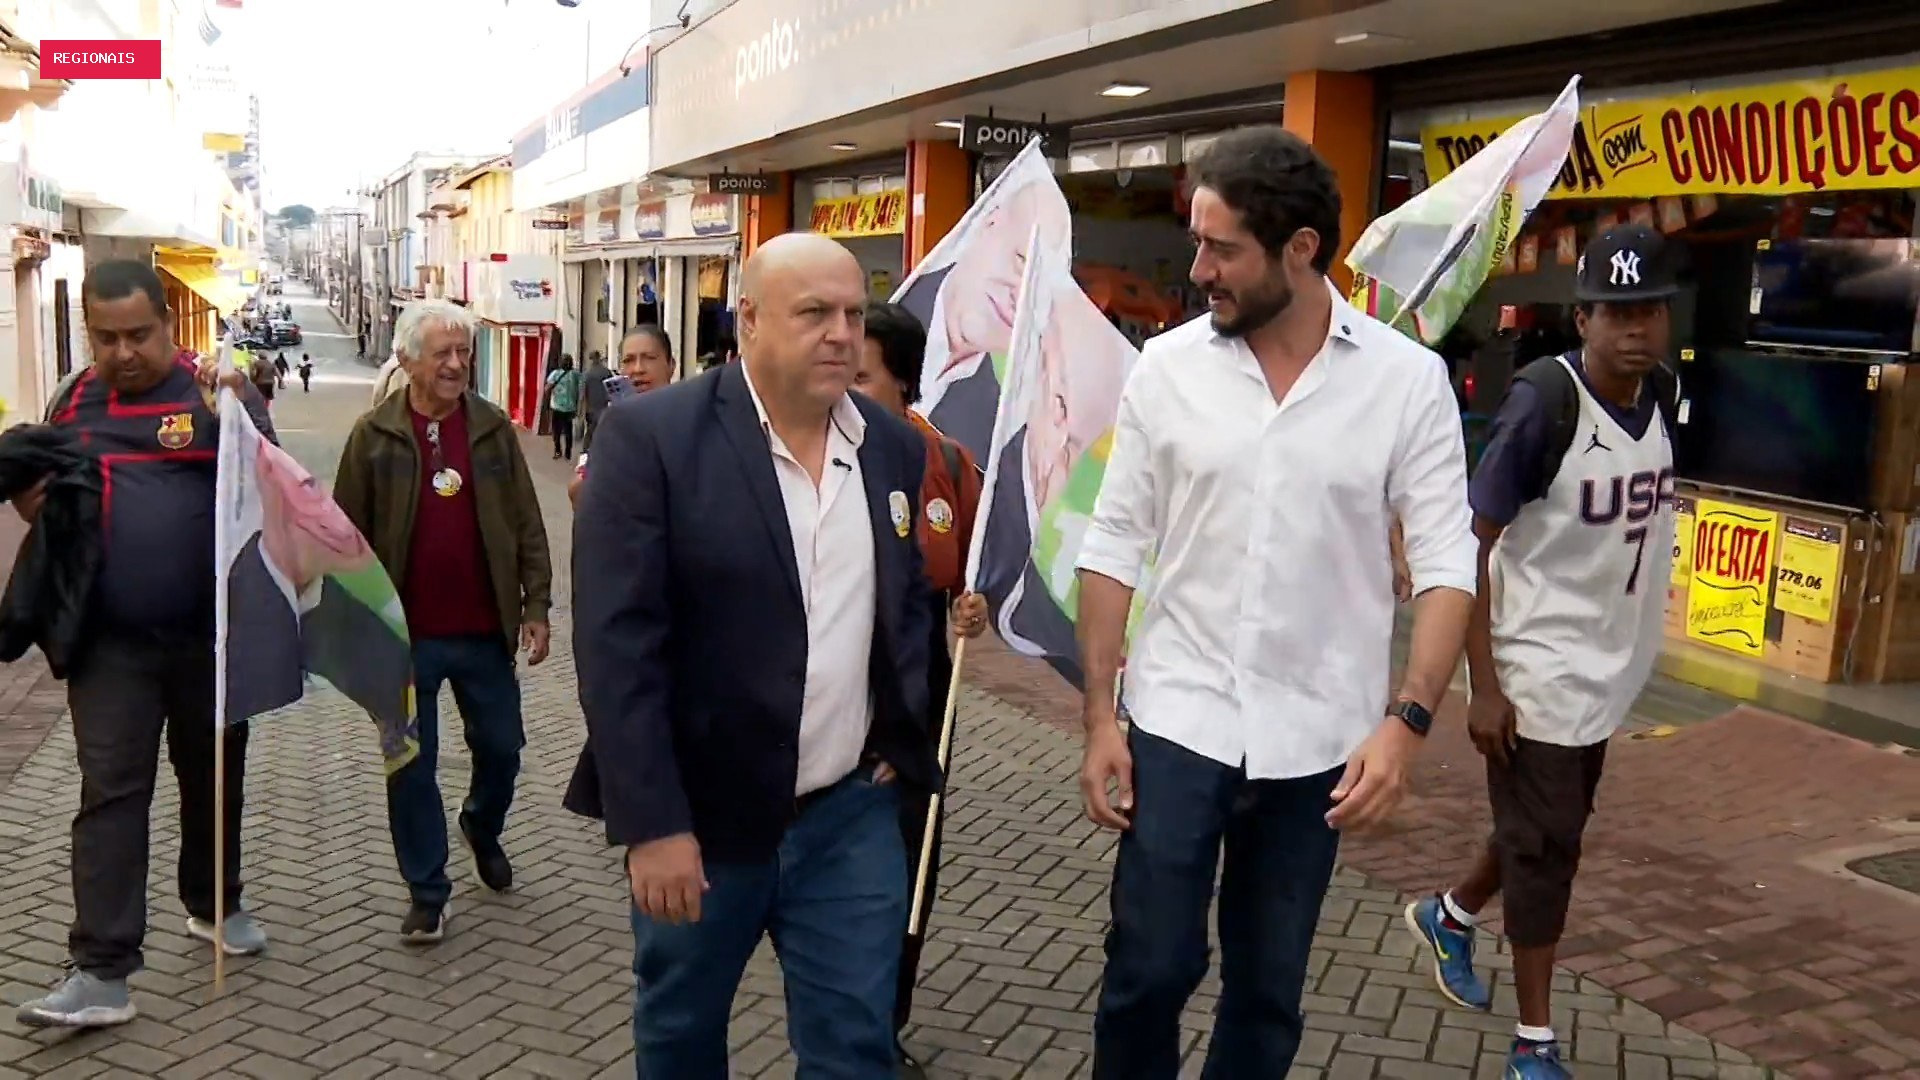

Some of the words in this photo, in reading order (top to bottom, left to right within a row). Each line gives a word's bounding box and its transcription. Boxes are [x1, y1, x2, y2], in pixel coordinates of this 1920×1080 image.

[735, 16, 800, 99] ponto:
[1624, 527, 1648, 596] 7
[1695, 519, 1770, 586] OFERTA
